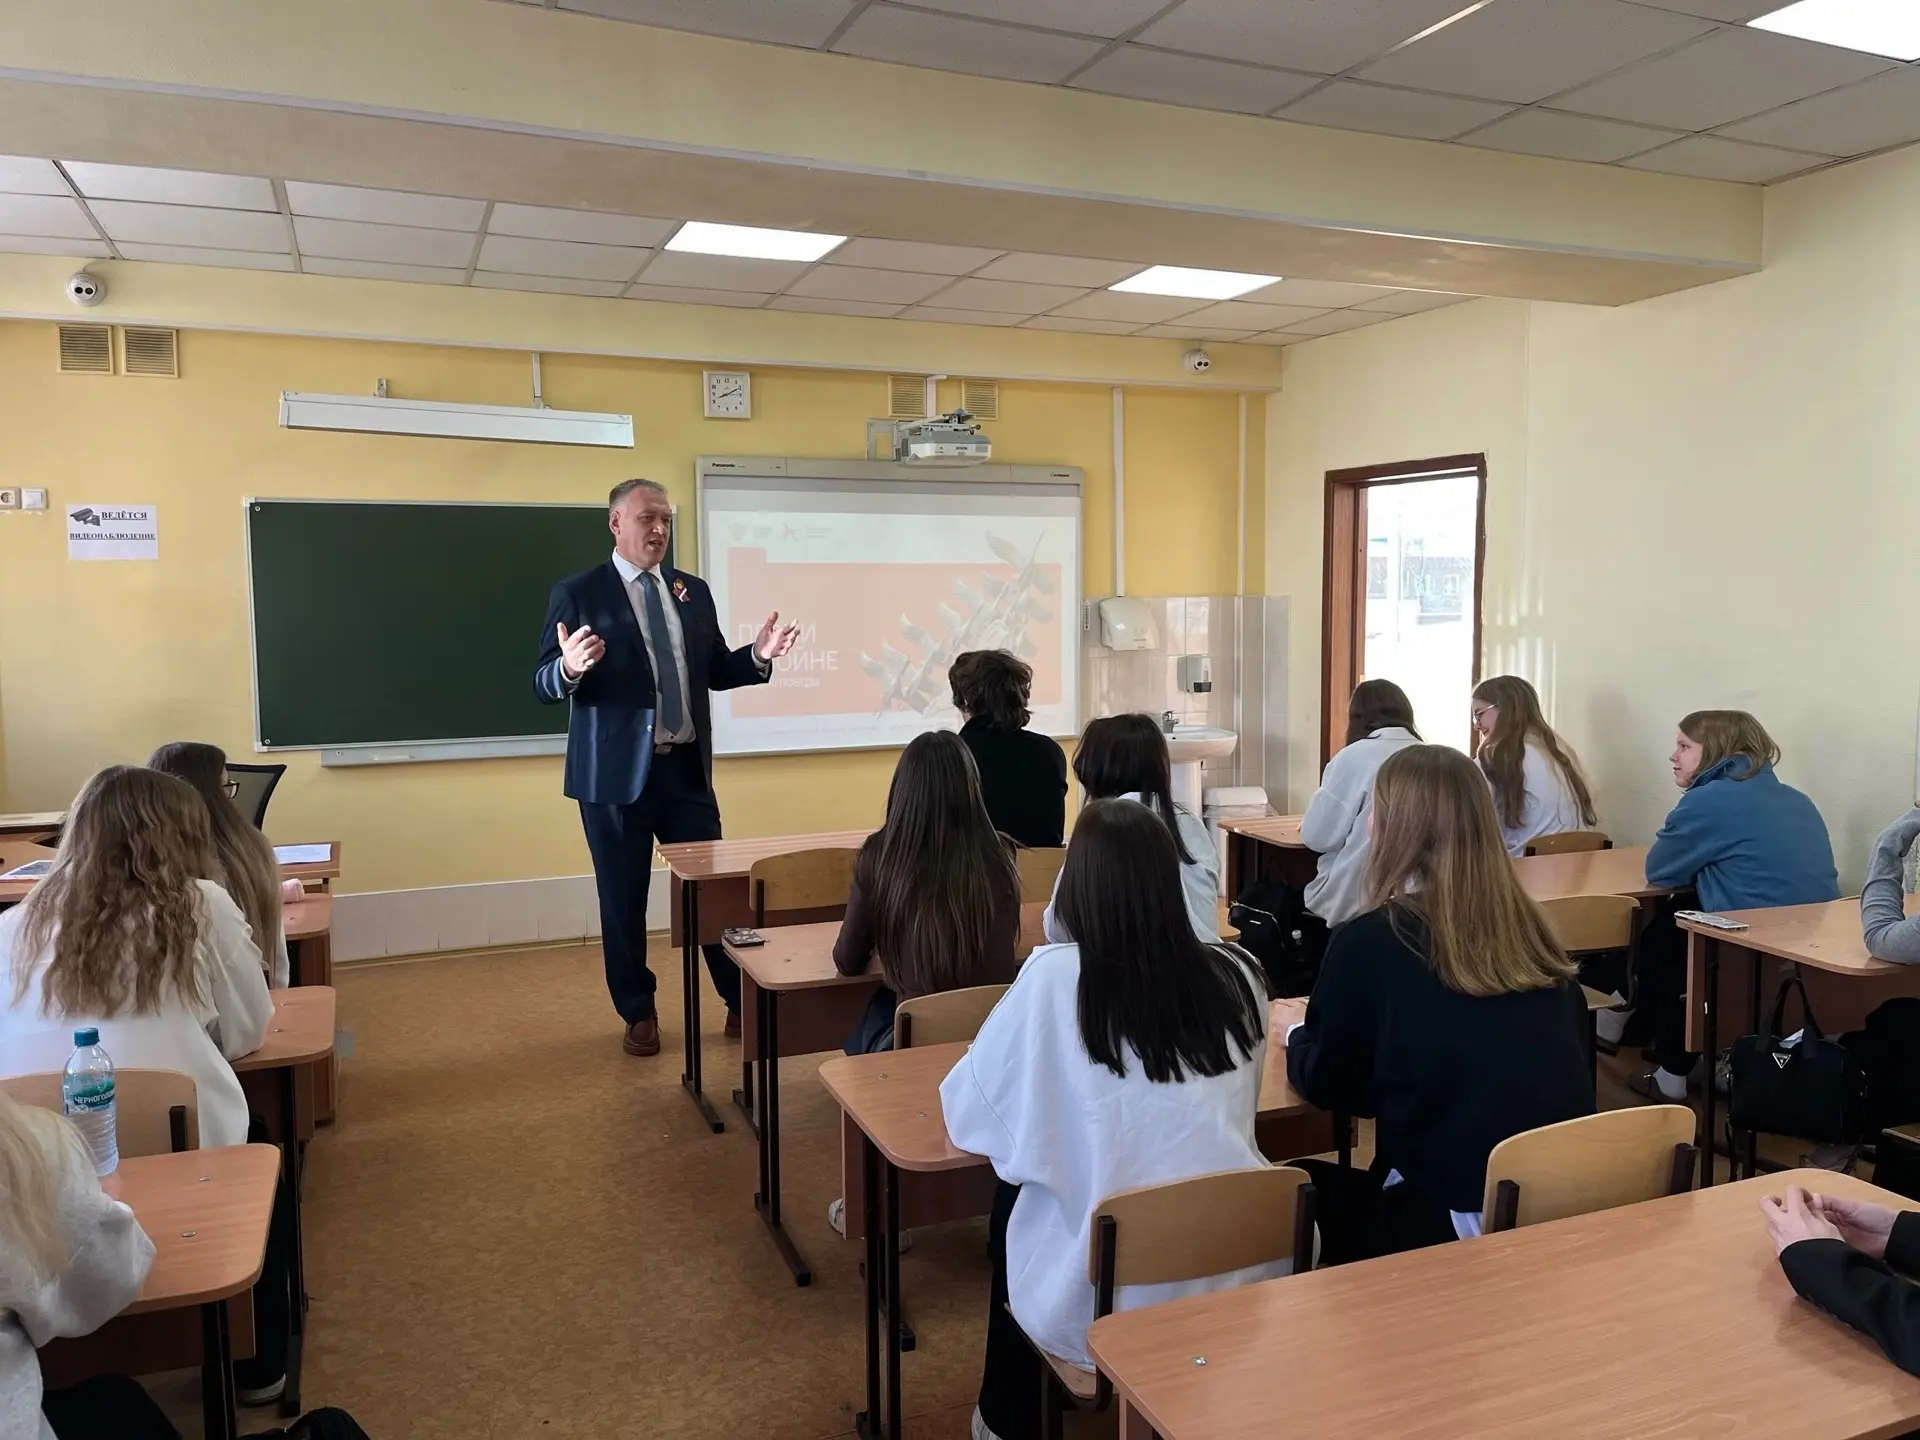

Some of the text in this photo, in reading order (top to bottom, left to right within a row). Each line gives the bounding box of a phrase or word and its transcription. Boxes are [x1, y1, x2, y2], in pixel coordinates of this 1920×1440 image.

[101, 510, 148, 520] ВЕДЁТСЯ
[69, 532, 156, 541] ВИДЕОНАБЛЮДЕНИЕ
[776, 645, 839, 671] ОЙНЕ
